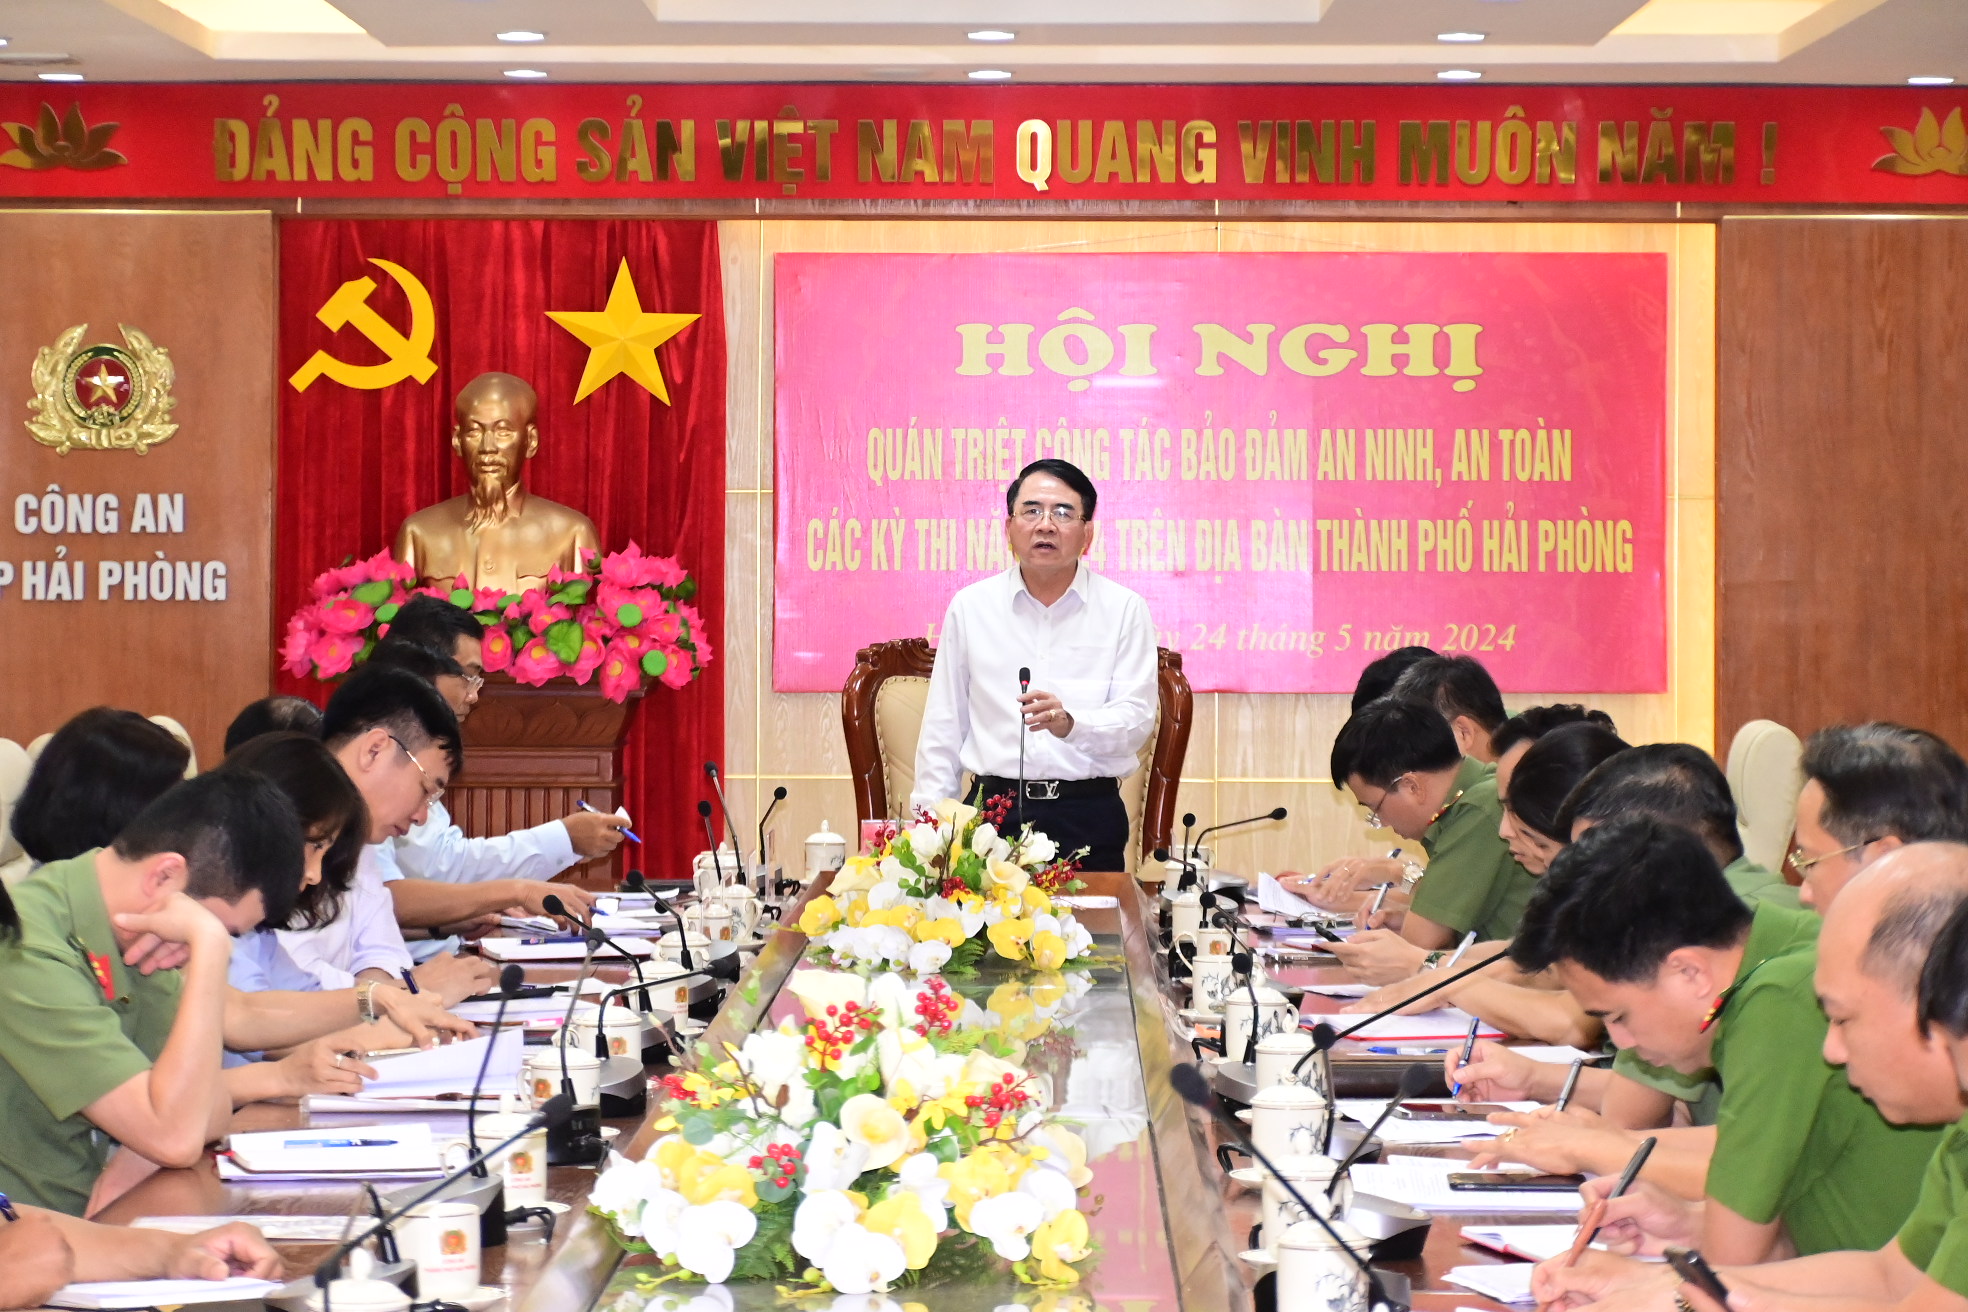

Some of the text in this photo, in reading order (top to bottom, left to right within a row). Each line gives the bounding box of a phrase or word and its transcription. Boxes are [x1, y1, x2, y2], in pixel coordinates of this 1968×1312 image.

[212, 94, 1778, 195] ĐẢNG CỘNG SẢN VIỆT NAM QUANG VINH MUÔN NĂM !
[955, 307, 1484, 392] HỘI NGHỊ
[867, 410, 1572, 492] QUÁN TRIỆT CÔNG TÁC BẢO ĐẢM AN NINH, AN TOÀN
[15, 483, 184, 534] CÔNG AN
[807, 507, 862, 571] CÁC
[871, 507, 905, 571] KỲ
[915, 519, 958, 571] THI
[1116, 508, 1186, 571] TRÊN
[1195, 519, 1242, 584] ĐỊA
[1252, 508, 1308, 571] BÀN
[1317, 508, 1409, 572] THÀNH
[1418, 500, 1473, 572] PHỐ
[1483, 501, 1528, 572] HẢI
[1538, 506, 1633, 573] PHÒNG
[22, 545, 84, 600] HẢI
[99, 551, 227, 601] PHÒNG
[1192, 624, 1226, 650] 24
[1238, 623, 1326, 658] tháng
[1335, 624, 1352, 650] 5
[1364, 624, 1430, 650] năm
[1442, 623, 1517, 651] 2024
